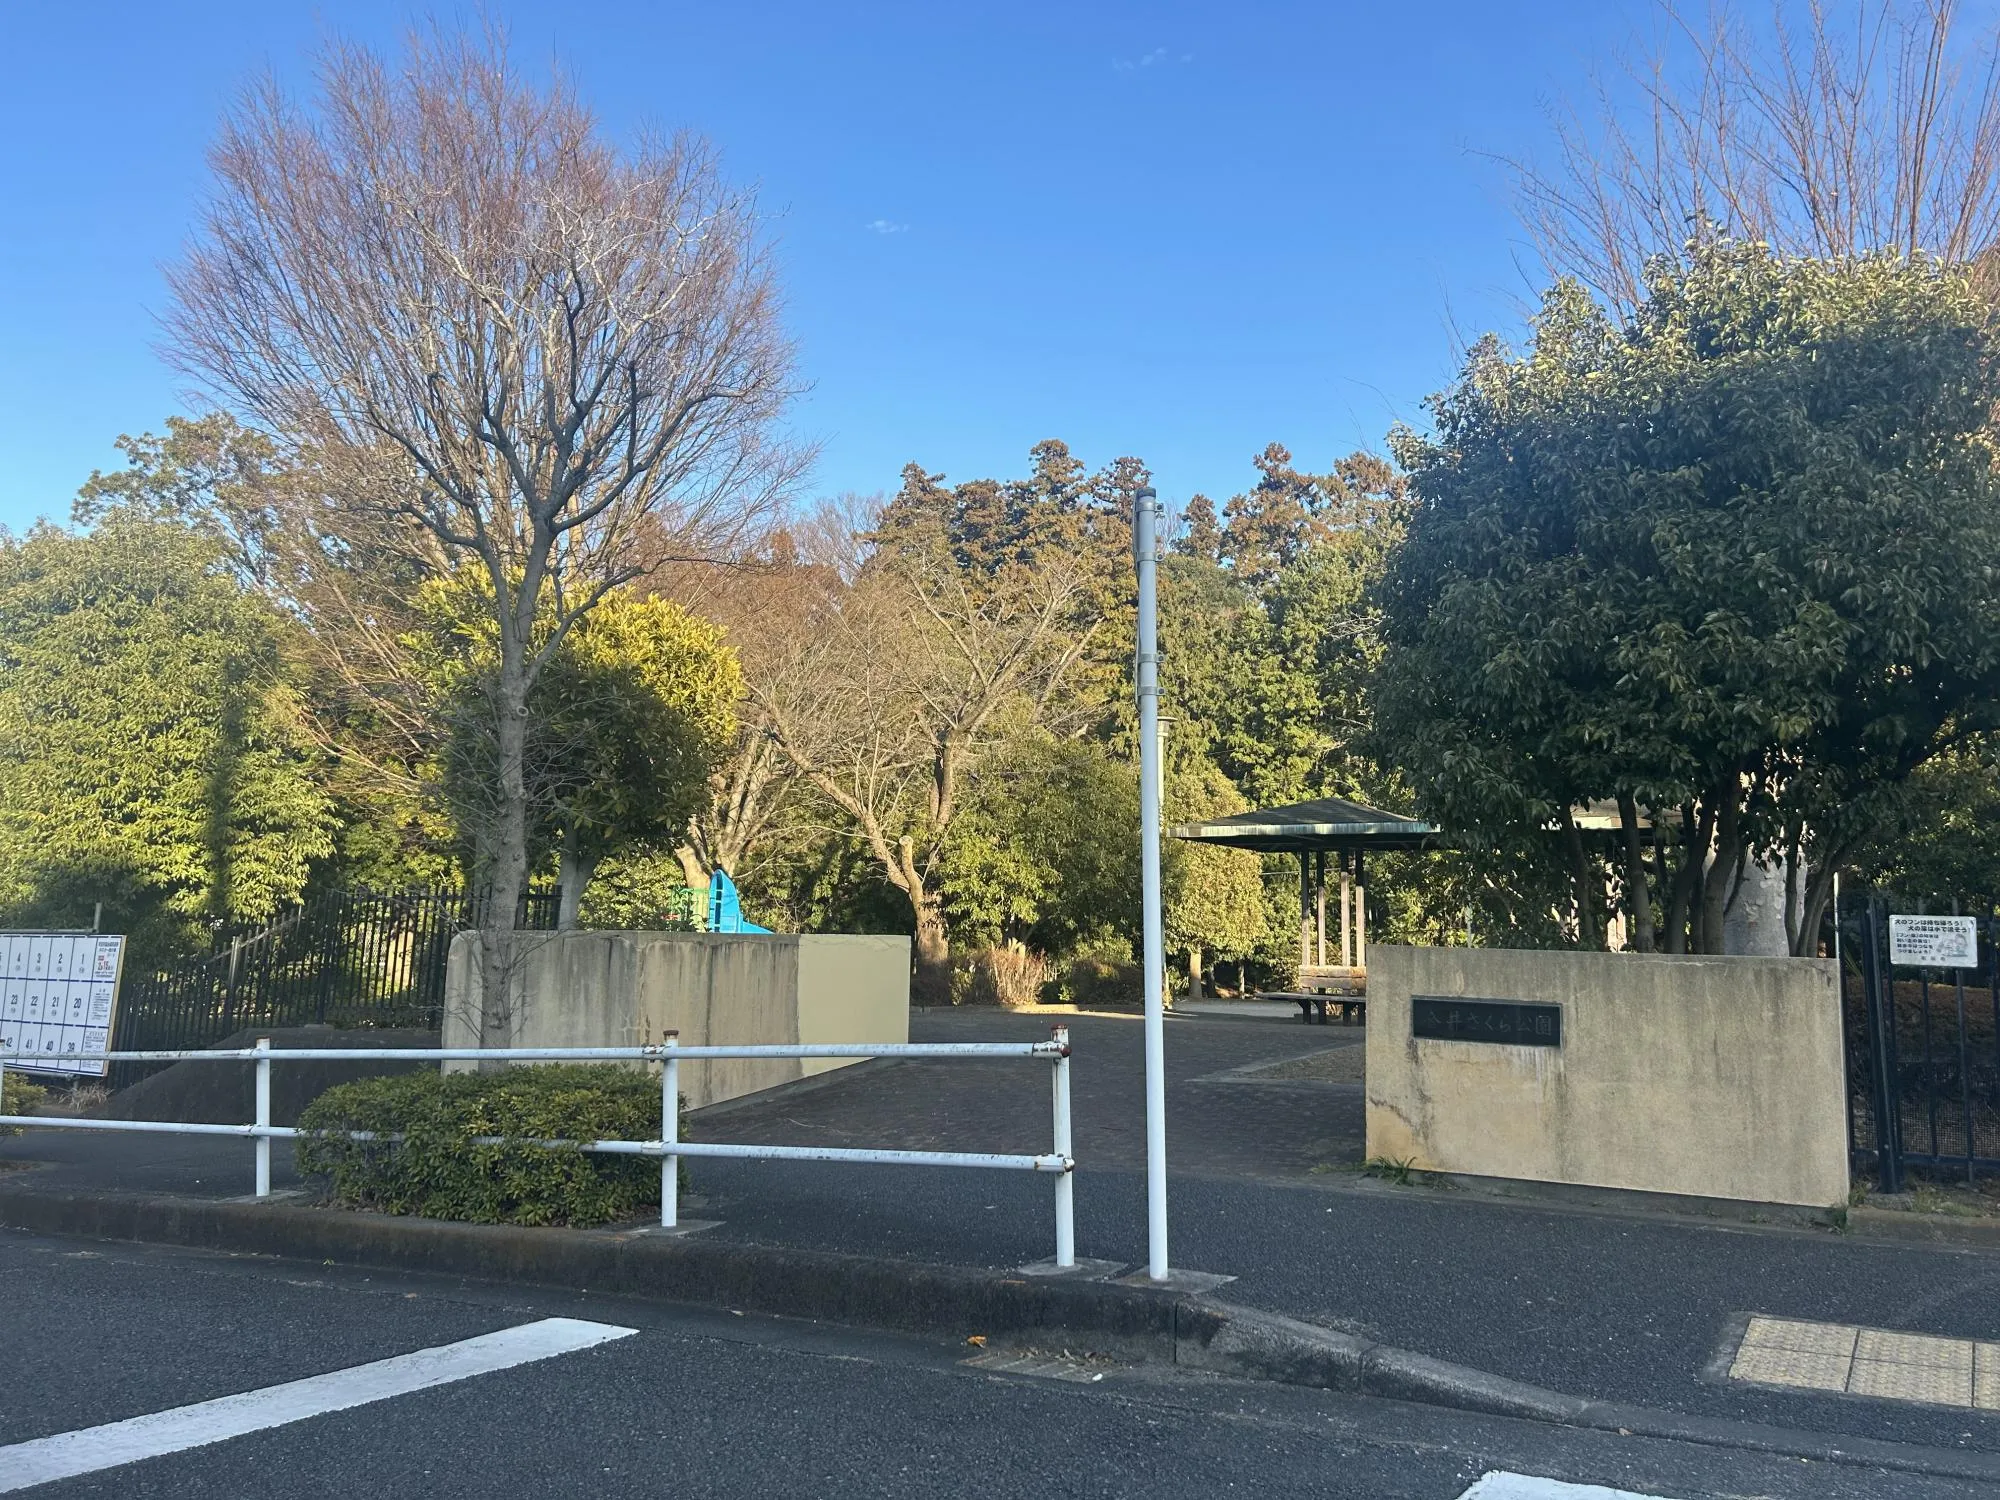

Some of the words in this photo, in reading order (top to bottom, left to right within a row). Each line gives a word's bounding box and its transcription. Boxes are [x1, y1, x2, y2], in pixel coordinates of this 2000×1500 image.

[58, 953, 63, 964] 2
[10, 994, 18, 1005] 23
[30, 996, 38, 1006] 22
[52, 996, 60, 1007] 21
[73, 998, 82, 1008] 20
[1424, 1009, 1552, 1036] 今井さくら公園
[5, 1037, 13, 1048] 42
[25, 1038, 33, 1049] 41
[46, 1040, 54, 1051] 40
